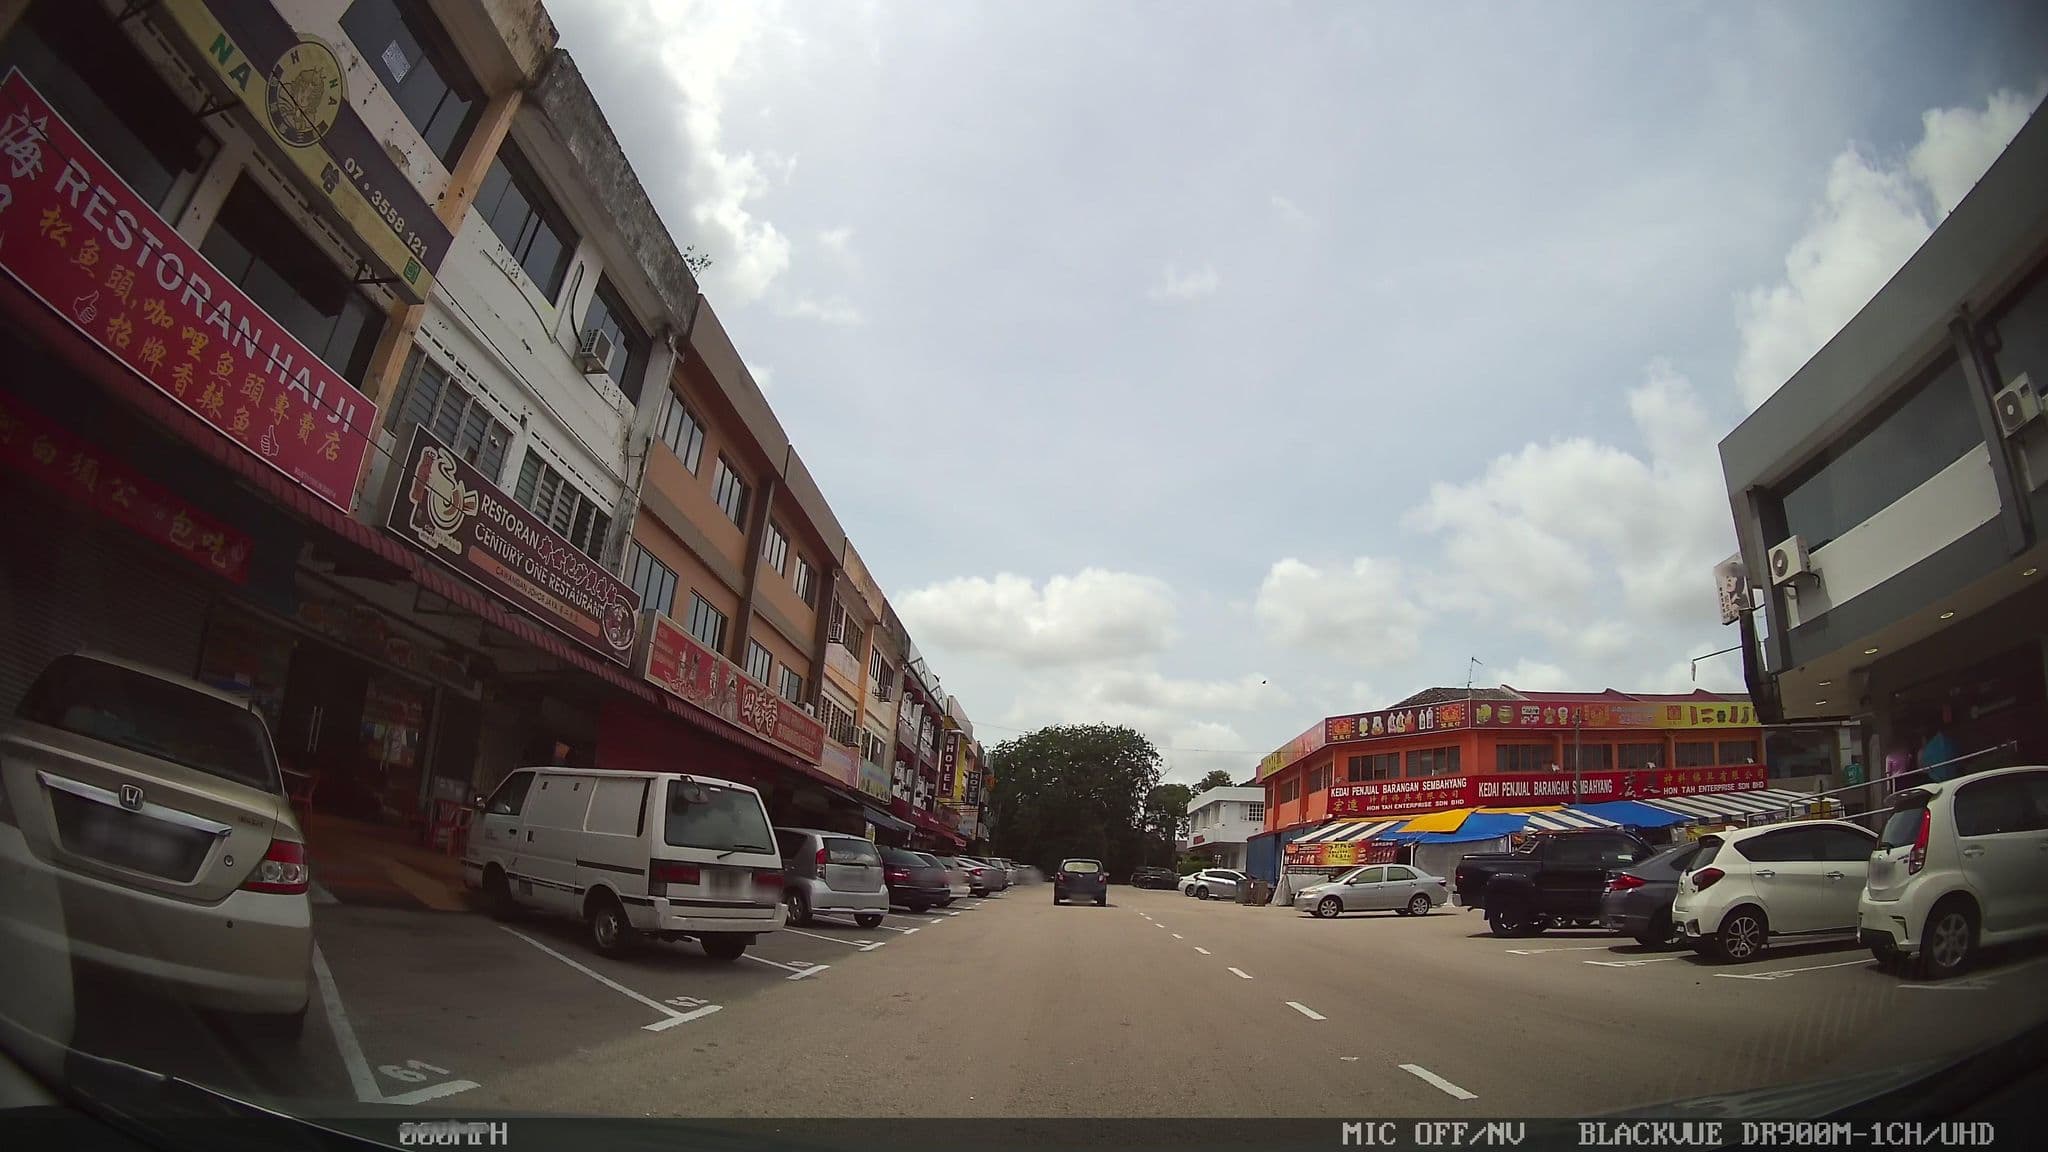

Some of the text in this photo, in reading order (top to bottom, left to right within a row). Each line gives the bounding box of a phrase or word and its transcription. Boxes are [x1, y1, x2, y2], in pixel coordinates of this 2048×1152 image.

[344, 157, 364, 182] 07
[371, 190, 405, 234] 3558
[406, 231, 428, 260] 121
[54, 157, 263, 360] RESTORAN
[265, 342, 326, 411] HAI
[326, 396, 356, 434] JI
[481, 494, 540, 550] RESTORAN
[475, 522, 524, 568] CENTURY
[524, 557, 549, 585] ONE
[549, 572, 605, 620] RESTAURANT
[942, 745, 955, 792] HOTEL
[1331, 778, 1467, 798] KEDAI PENJUAL BARANGAN SEMBAHYANG
[968, 773, 980, 804] HOTEL
[1394, 801, 1432, 810] ENTERPRISE
[1479, 782, 1500, 798] KEDAI
[1502, 781, 1530, 797] PENJUAL
[1534, 780, 1570, 796] BARANGAN
[1572, 779, 1612, 795] SMBAHYANG
[1663, 781, 1764, 796] HON TAH ENTERPRISE SDN BHD
